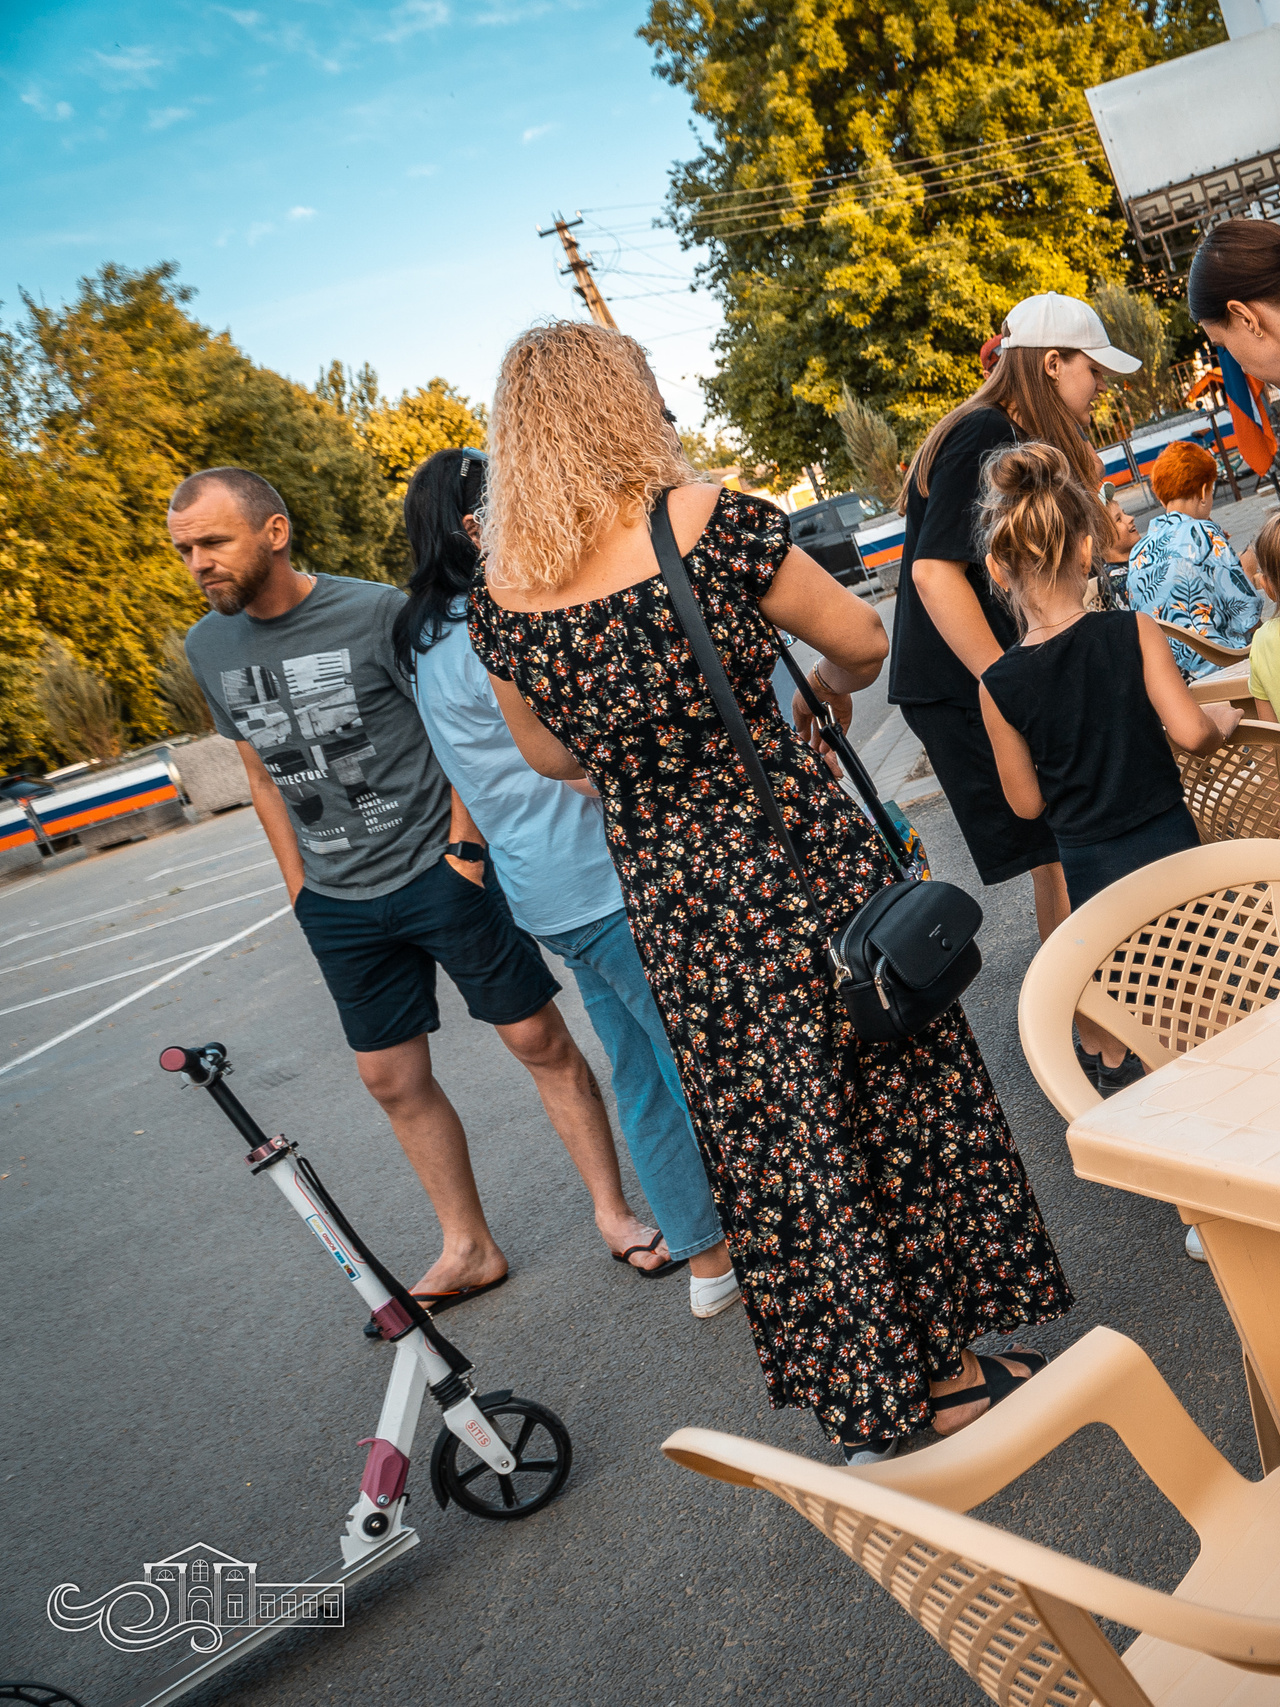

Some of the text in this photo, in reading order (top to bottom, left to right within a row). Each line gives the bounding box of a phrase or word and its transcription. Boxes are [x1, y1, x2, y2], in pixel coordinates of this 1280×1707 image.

[361, 800, 399, 818] CHALLENGE
[364, 816, 379, 826] AND
[367, 817, 403, 835] DISCOVERY
[467, 1421, 489, 1446] SITIS
